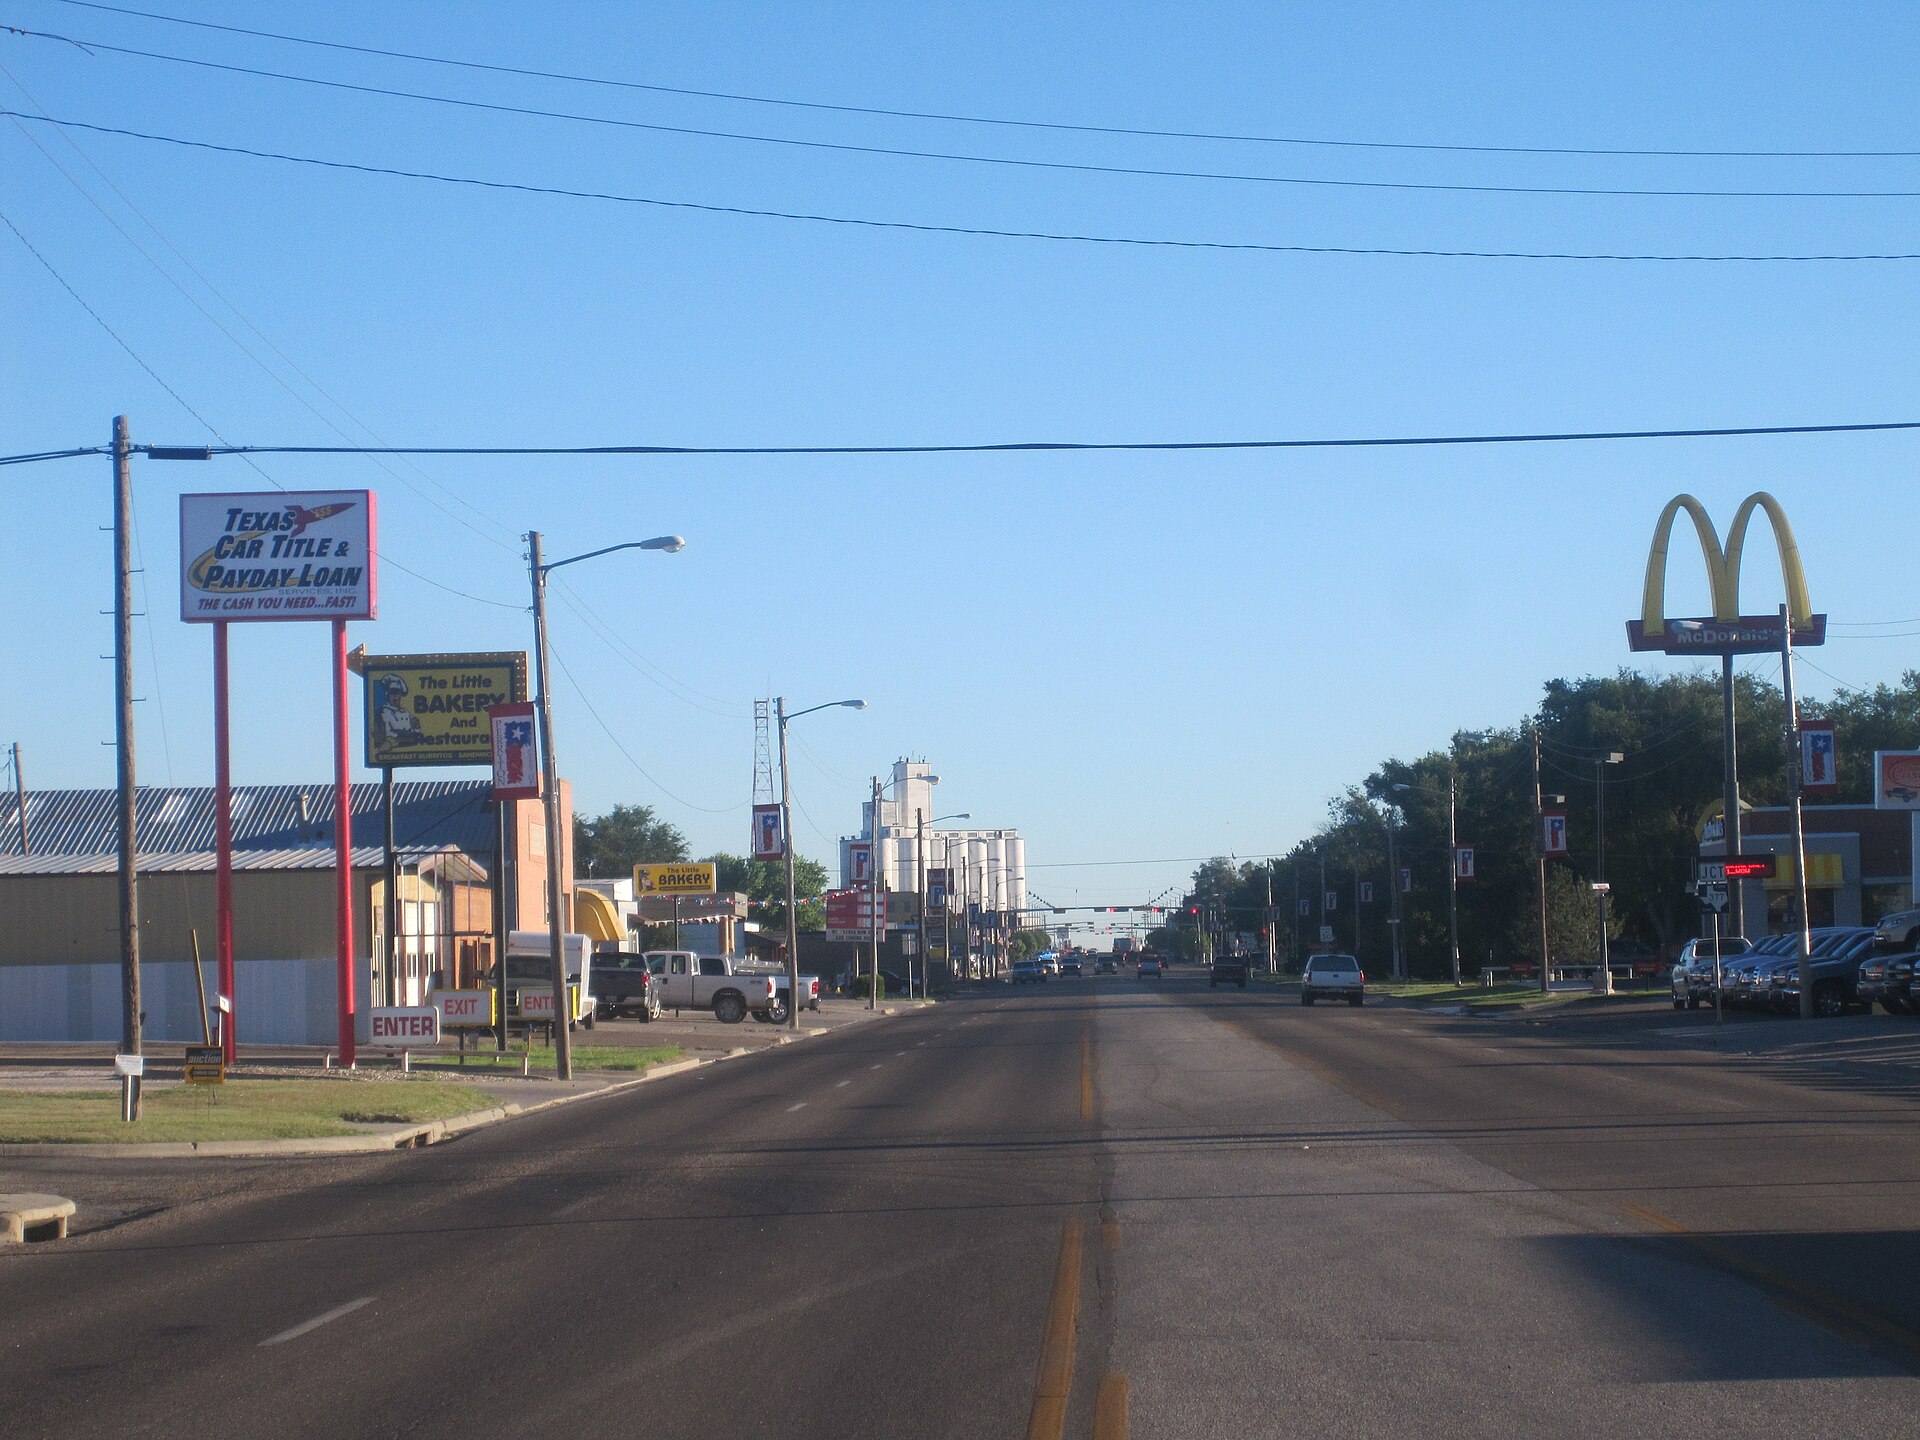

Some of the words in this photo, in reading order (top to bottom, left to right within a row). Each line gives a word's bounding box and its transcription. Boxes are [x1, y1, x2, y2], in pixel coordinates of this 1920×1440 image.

[224, 508, 296, 532] TEXAS
[214, 535, 264, 559] CAR
[269, 534, 332, 558] TITLE
[334, 541, 349, 557] &
[202, 565, 294, 588] PAYDAY
[297, 563, 363, 587] LOAN
[199, 598, 219, 610] THE
[222, 598, 254, 610] CASH
[257, 597, 285, 609] YOU
[418, 676, 448, 689] The
[452, 674, 492, 689] Little
[450, 716, 477, 728] And
[659, 873, 710, 885] BAKERY
[1701, 866, 1724, 878] JCT
[444, 999, 478, 1015] EXIT
[372, 1016, 433, 1036] ENTER
[187, 1054, 221, 1064] auction
